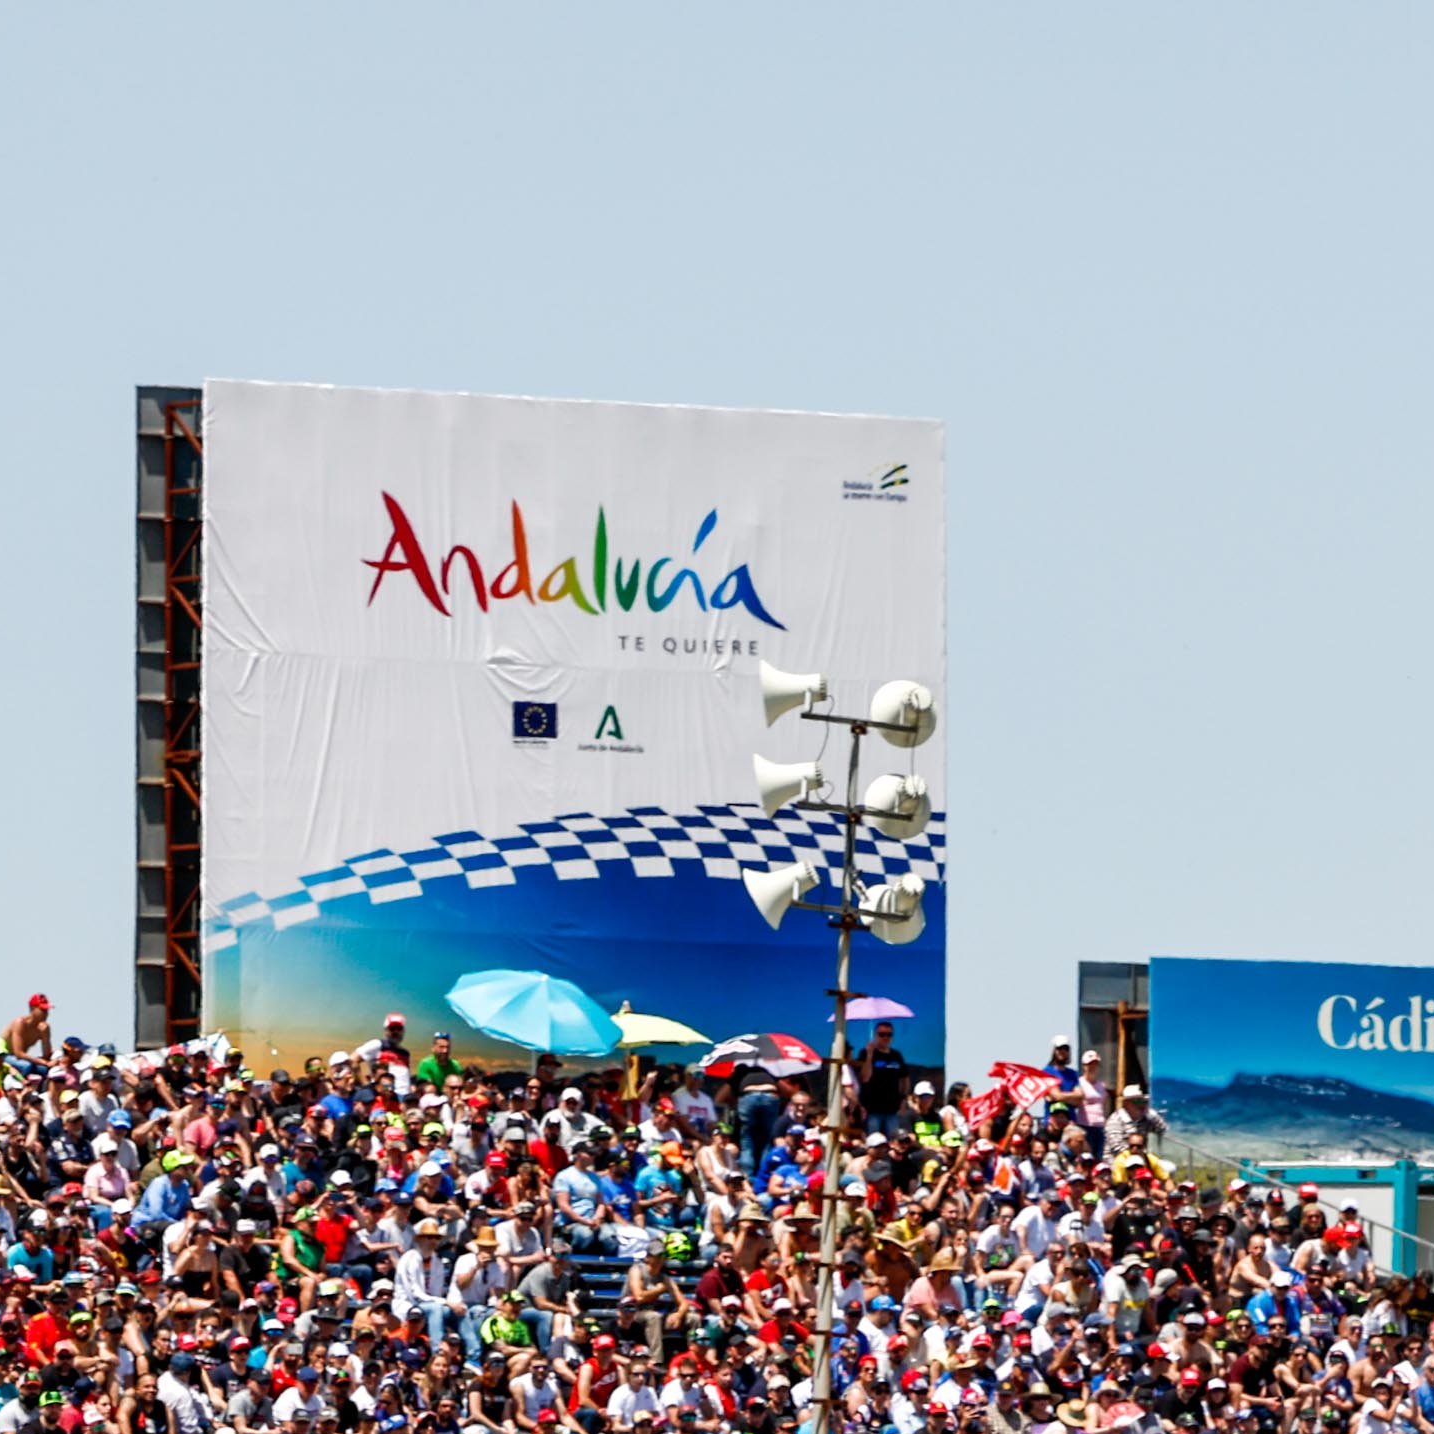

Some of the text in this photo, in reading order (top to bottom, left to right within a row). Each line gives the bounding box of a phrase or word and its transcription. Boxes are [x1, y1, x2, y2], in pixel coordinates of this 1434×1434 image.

[361, 490, 789, 632] Andalucía
[618, 636, 759, 656] TE QUIERE
